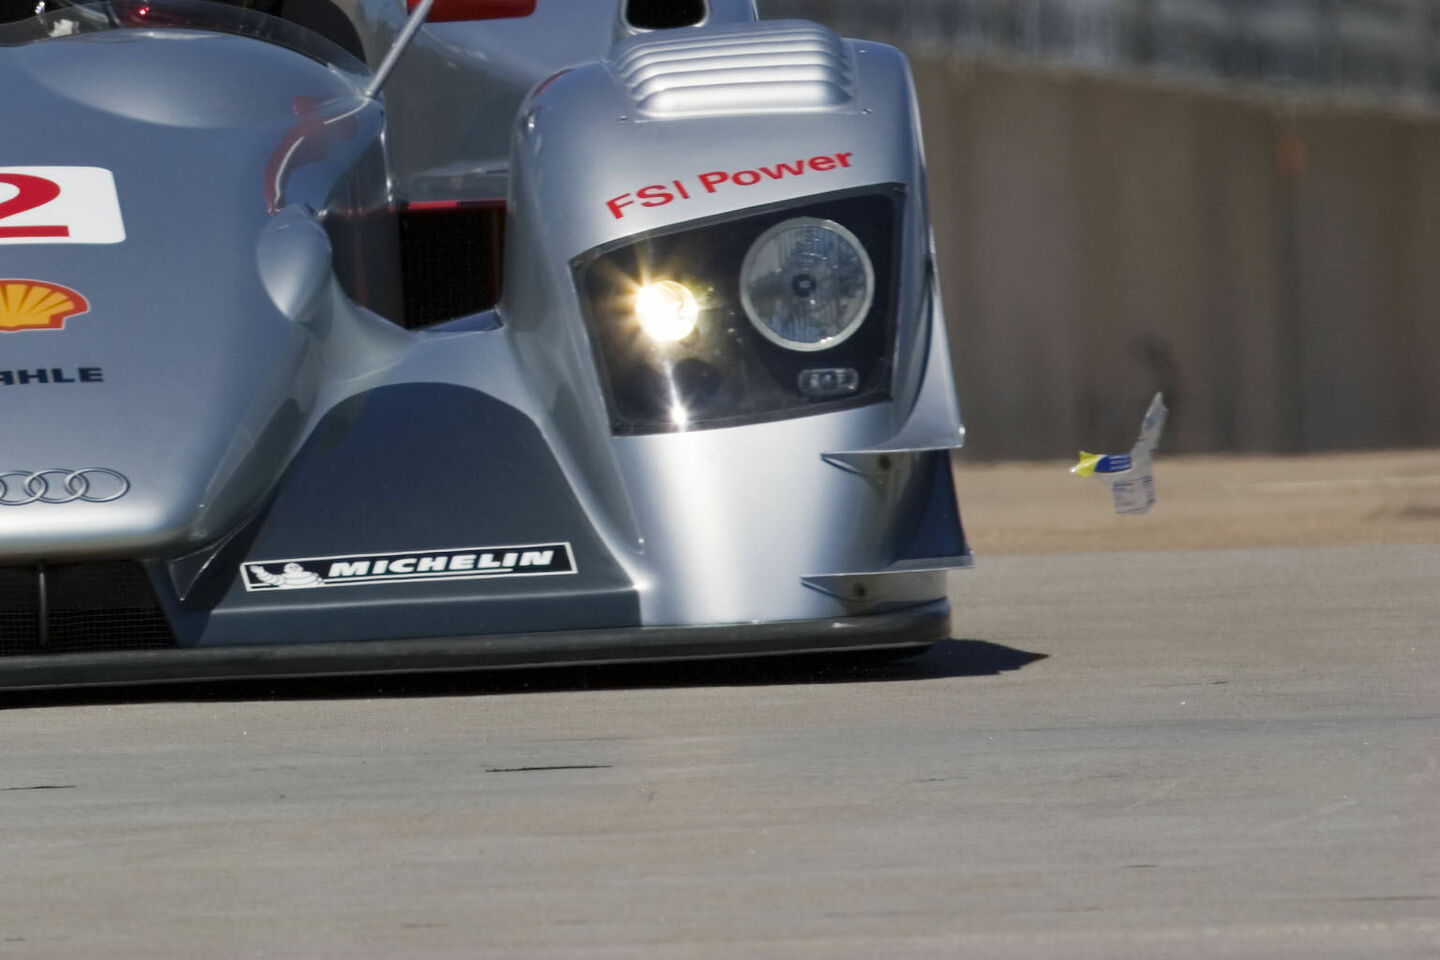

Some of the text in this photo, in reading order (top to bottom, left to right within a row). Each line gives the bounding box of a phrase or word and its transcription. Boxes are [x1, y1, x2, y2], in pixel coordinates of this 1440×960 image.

[606, 152, 853, 219] FSI Power
[328, 550, 554, 578] MICHELIN
